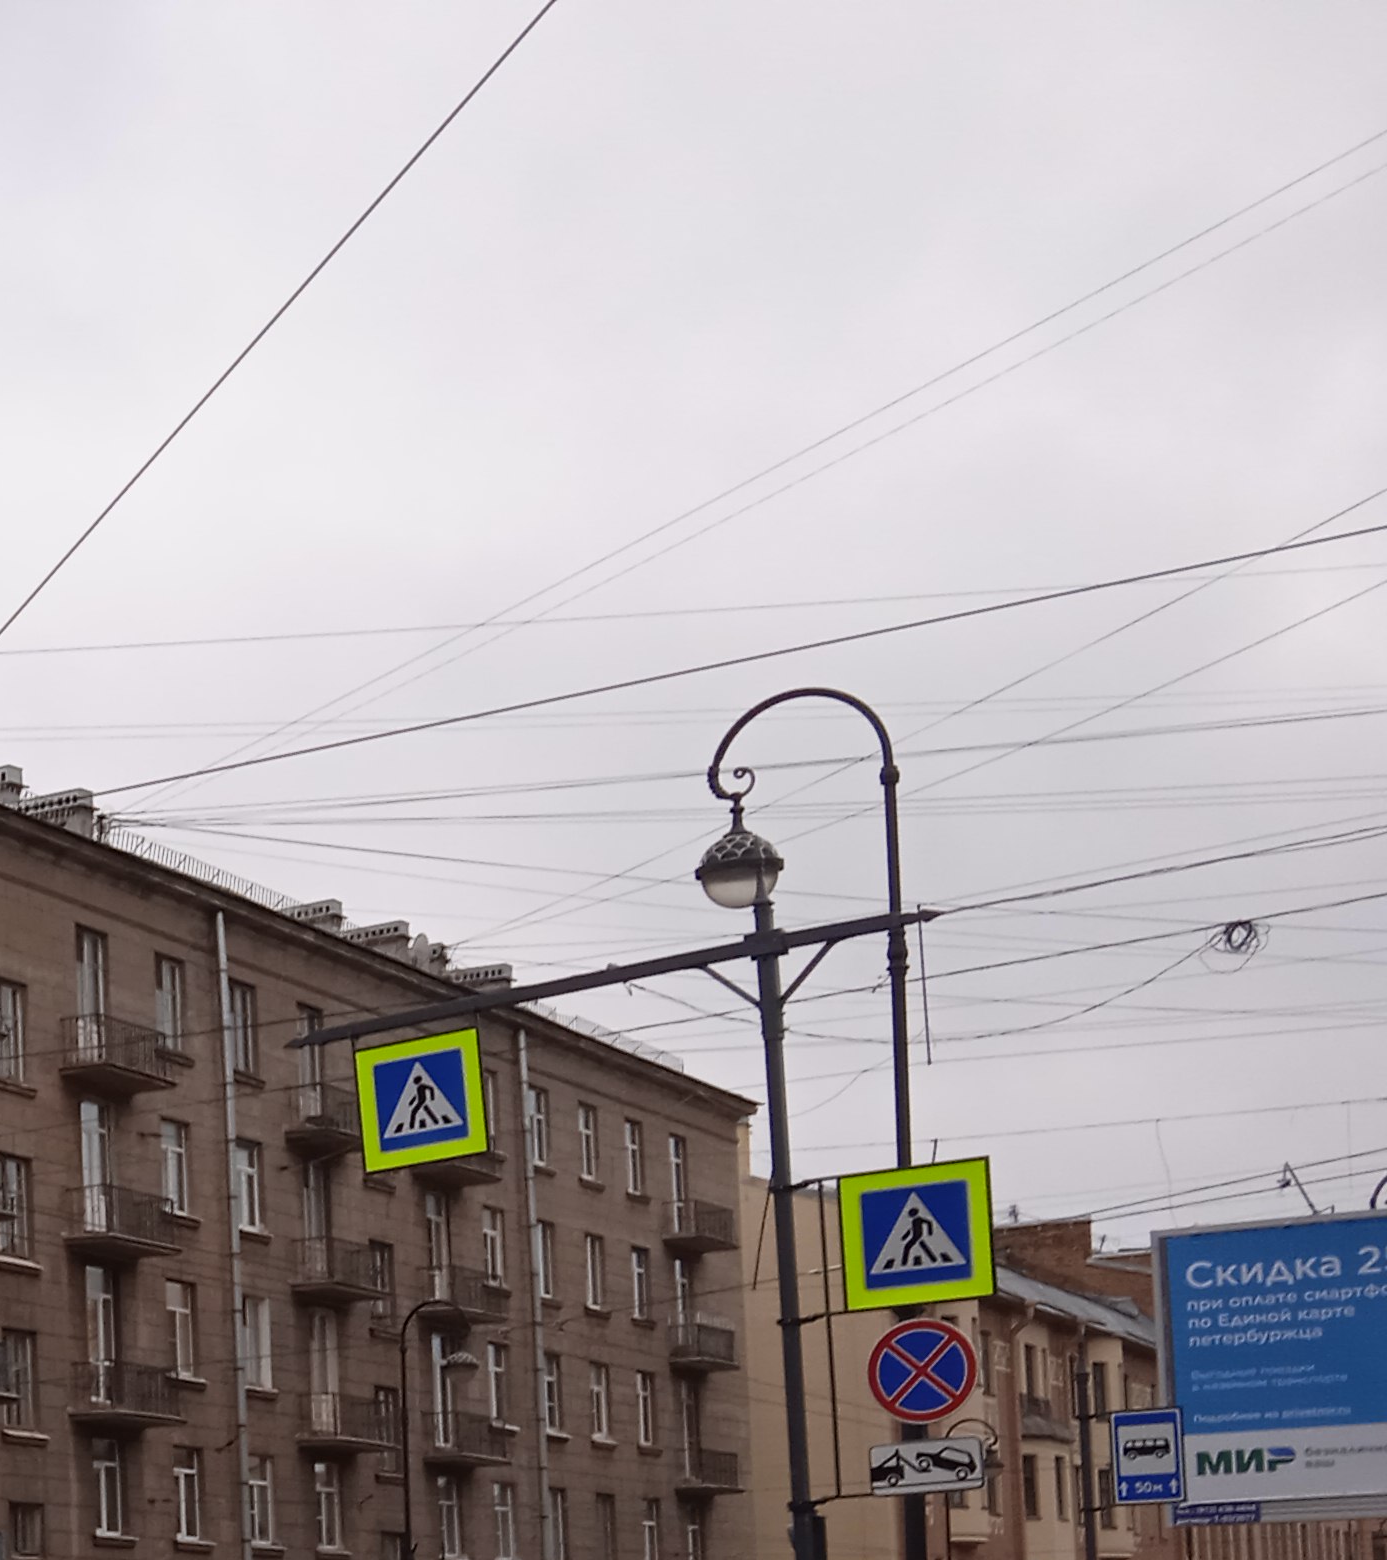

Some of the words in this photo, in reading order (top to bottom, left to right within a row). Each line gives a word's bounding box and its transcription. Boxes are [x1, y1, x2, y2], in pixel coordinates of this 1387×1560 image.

[1185, 1254, 1342, 1290] Скидка
[1357, 1245, 1387, 1276] 2
[1186, 1297, 1223, 1313] при
[1228, 1291, 1297, 1308] оплате
[1187, 1315, 1212, 1329] по
[1218, 1307, 1292, 1327] Единой
[1298, 1304, 1356, 1322] карте
[1188, 1325, 1323, 1348] петербуржца
[1196, 1445, 1297, 1476] МИР
[1134, 1480, 1164, 1494] 50м
